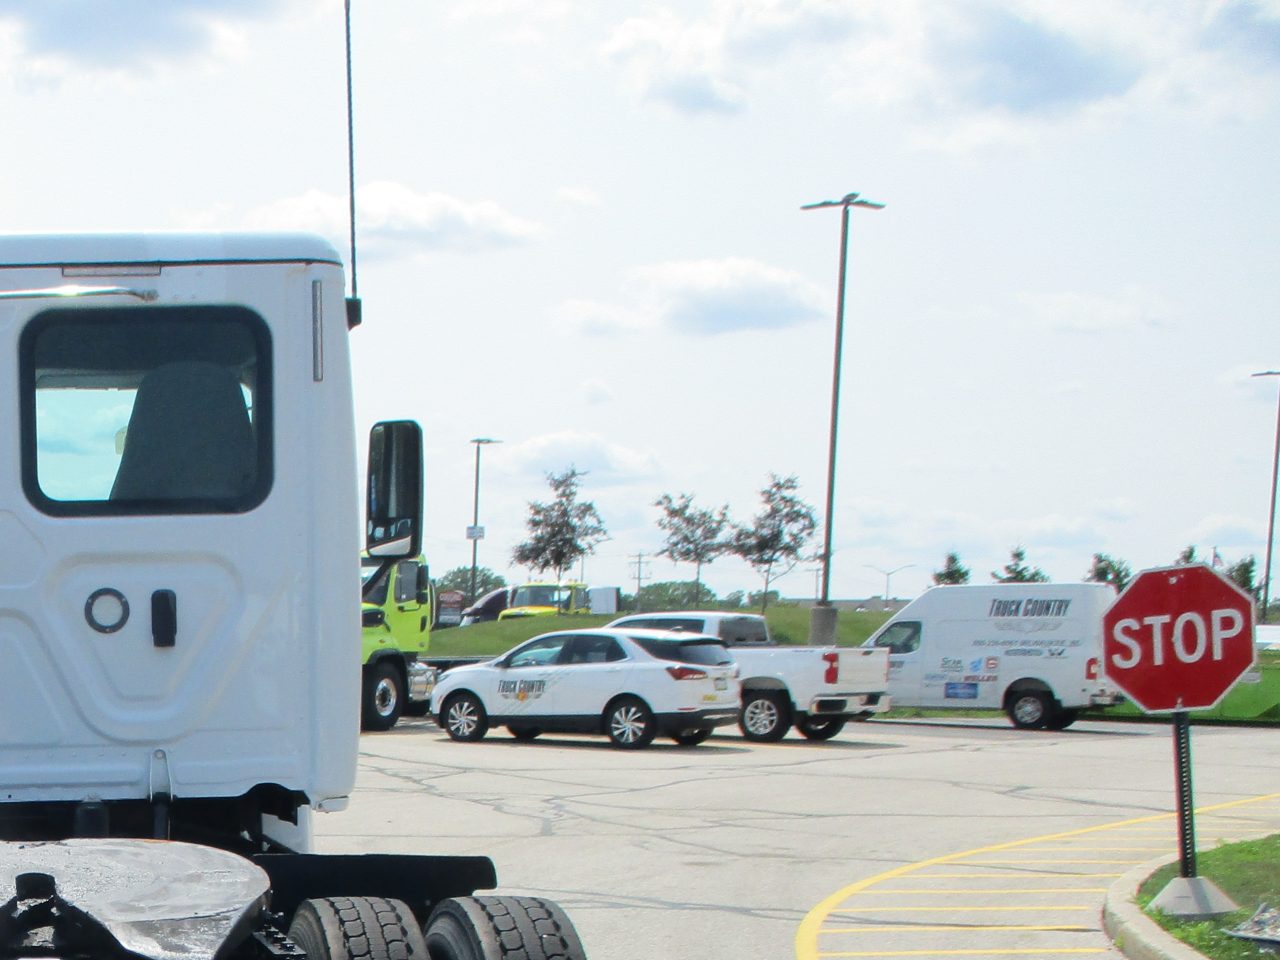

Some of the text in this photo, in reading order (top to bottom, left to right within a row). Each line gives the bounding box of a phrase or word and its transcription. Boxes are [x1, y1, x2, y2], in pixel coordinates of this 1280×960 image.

[988, 598, 1072, 617] TRUCK COUNTRY
[1111, 608, 1244, 670] STOP
[497, 680, 546, 693] TRUCK COUNTRY
